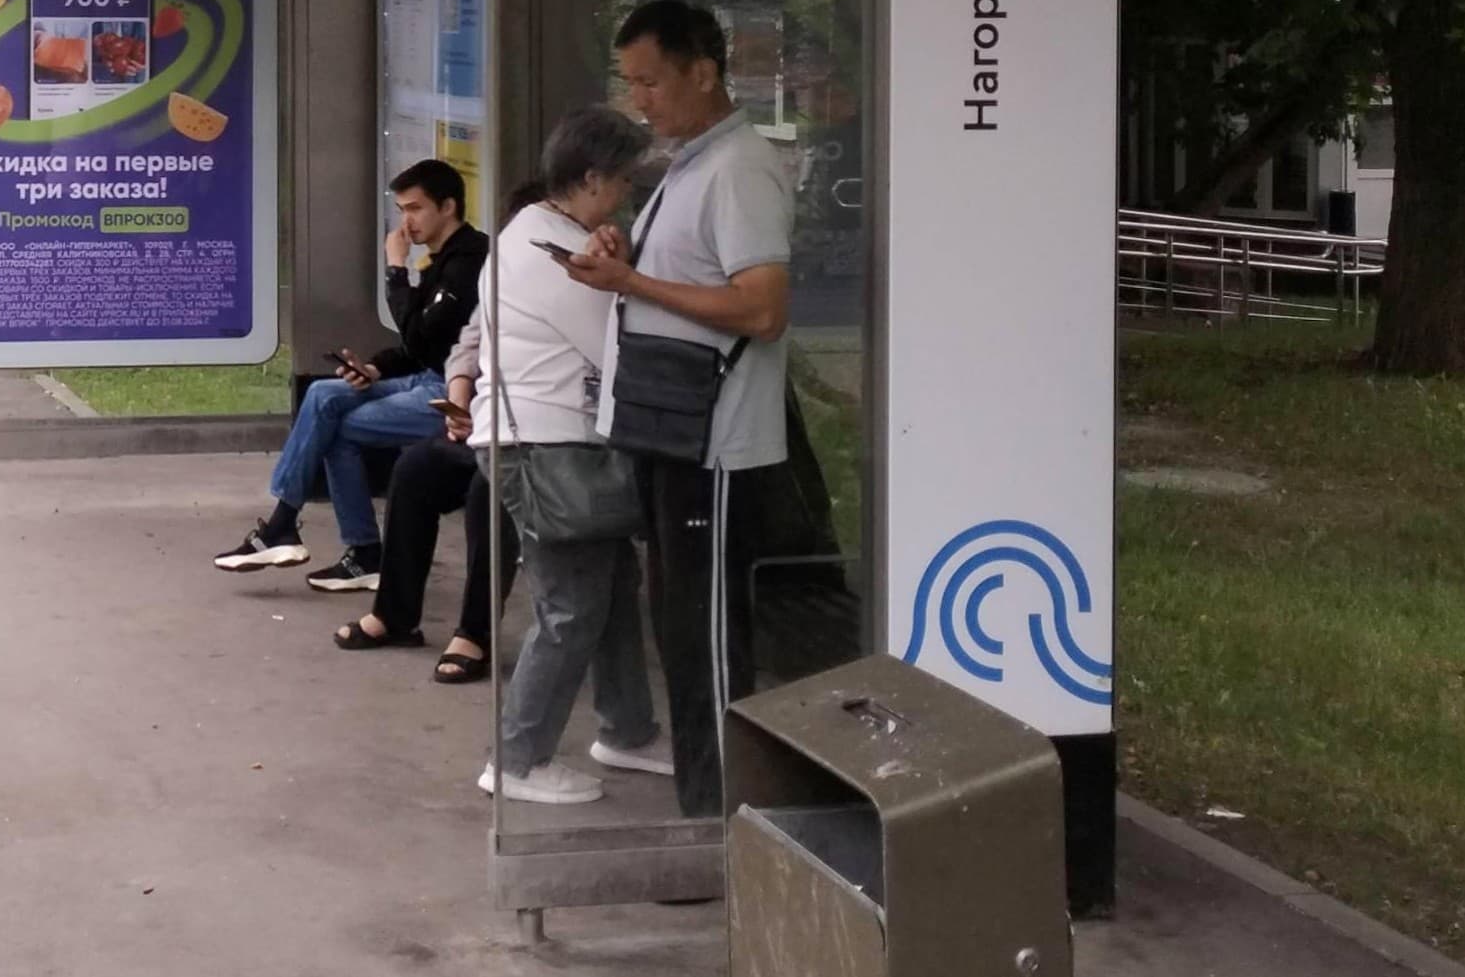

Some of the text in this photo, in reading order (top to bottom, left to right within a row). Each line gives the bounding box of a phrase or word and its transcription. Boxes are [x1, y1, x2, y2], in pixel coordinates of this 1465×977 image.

[75, 155, 107, 173] на
[115, 154, 214, 176] первые
[16, 177, 167, 204] три заказа!
[103, 212, 185, 226] ВПРОК300
